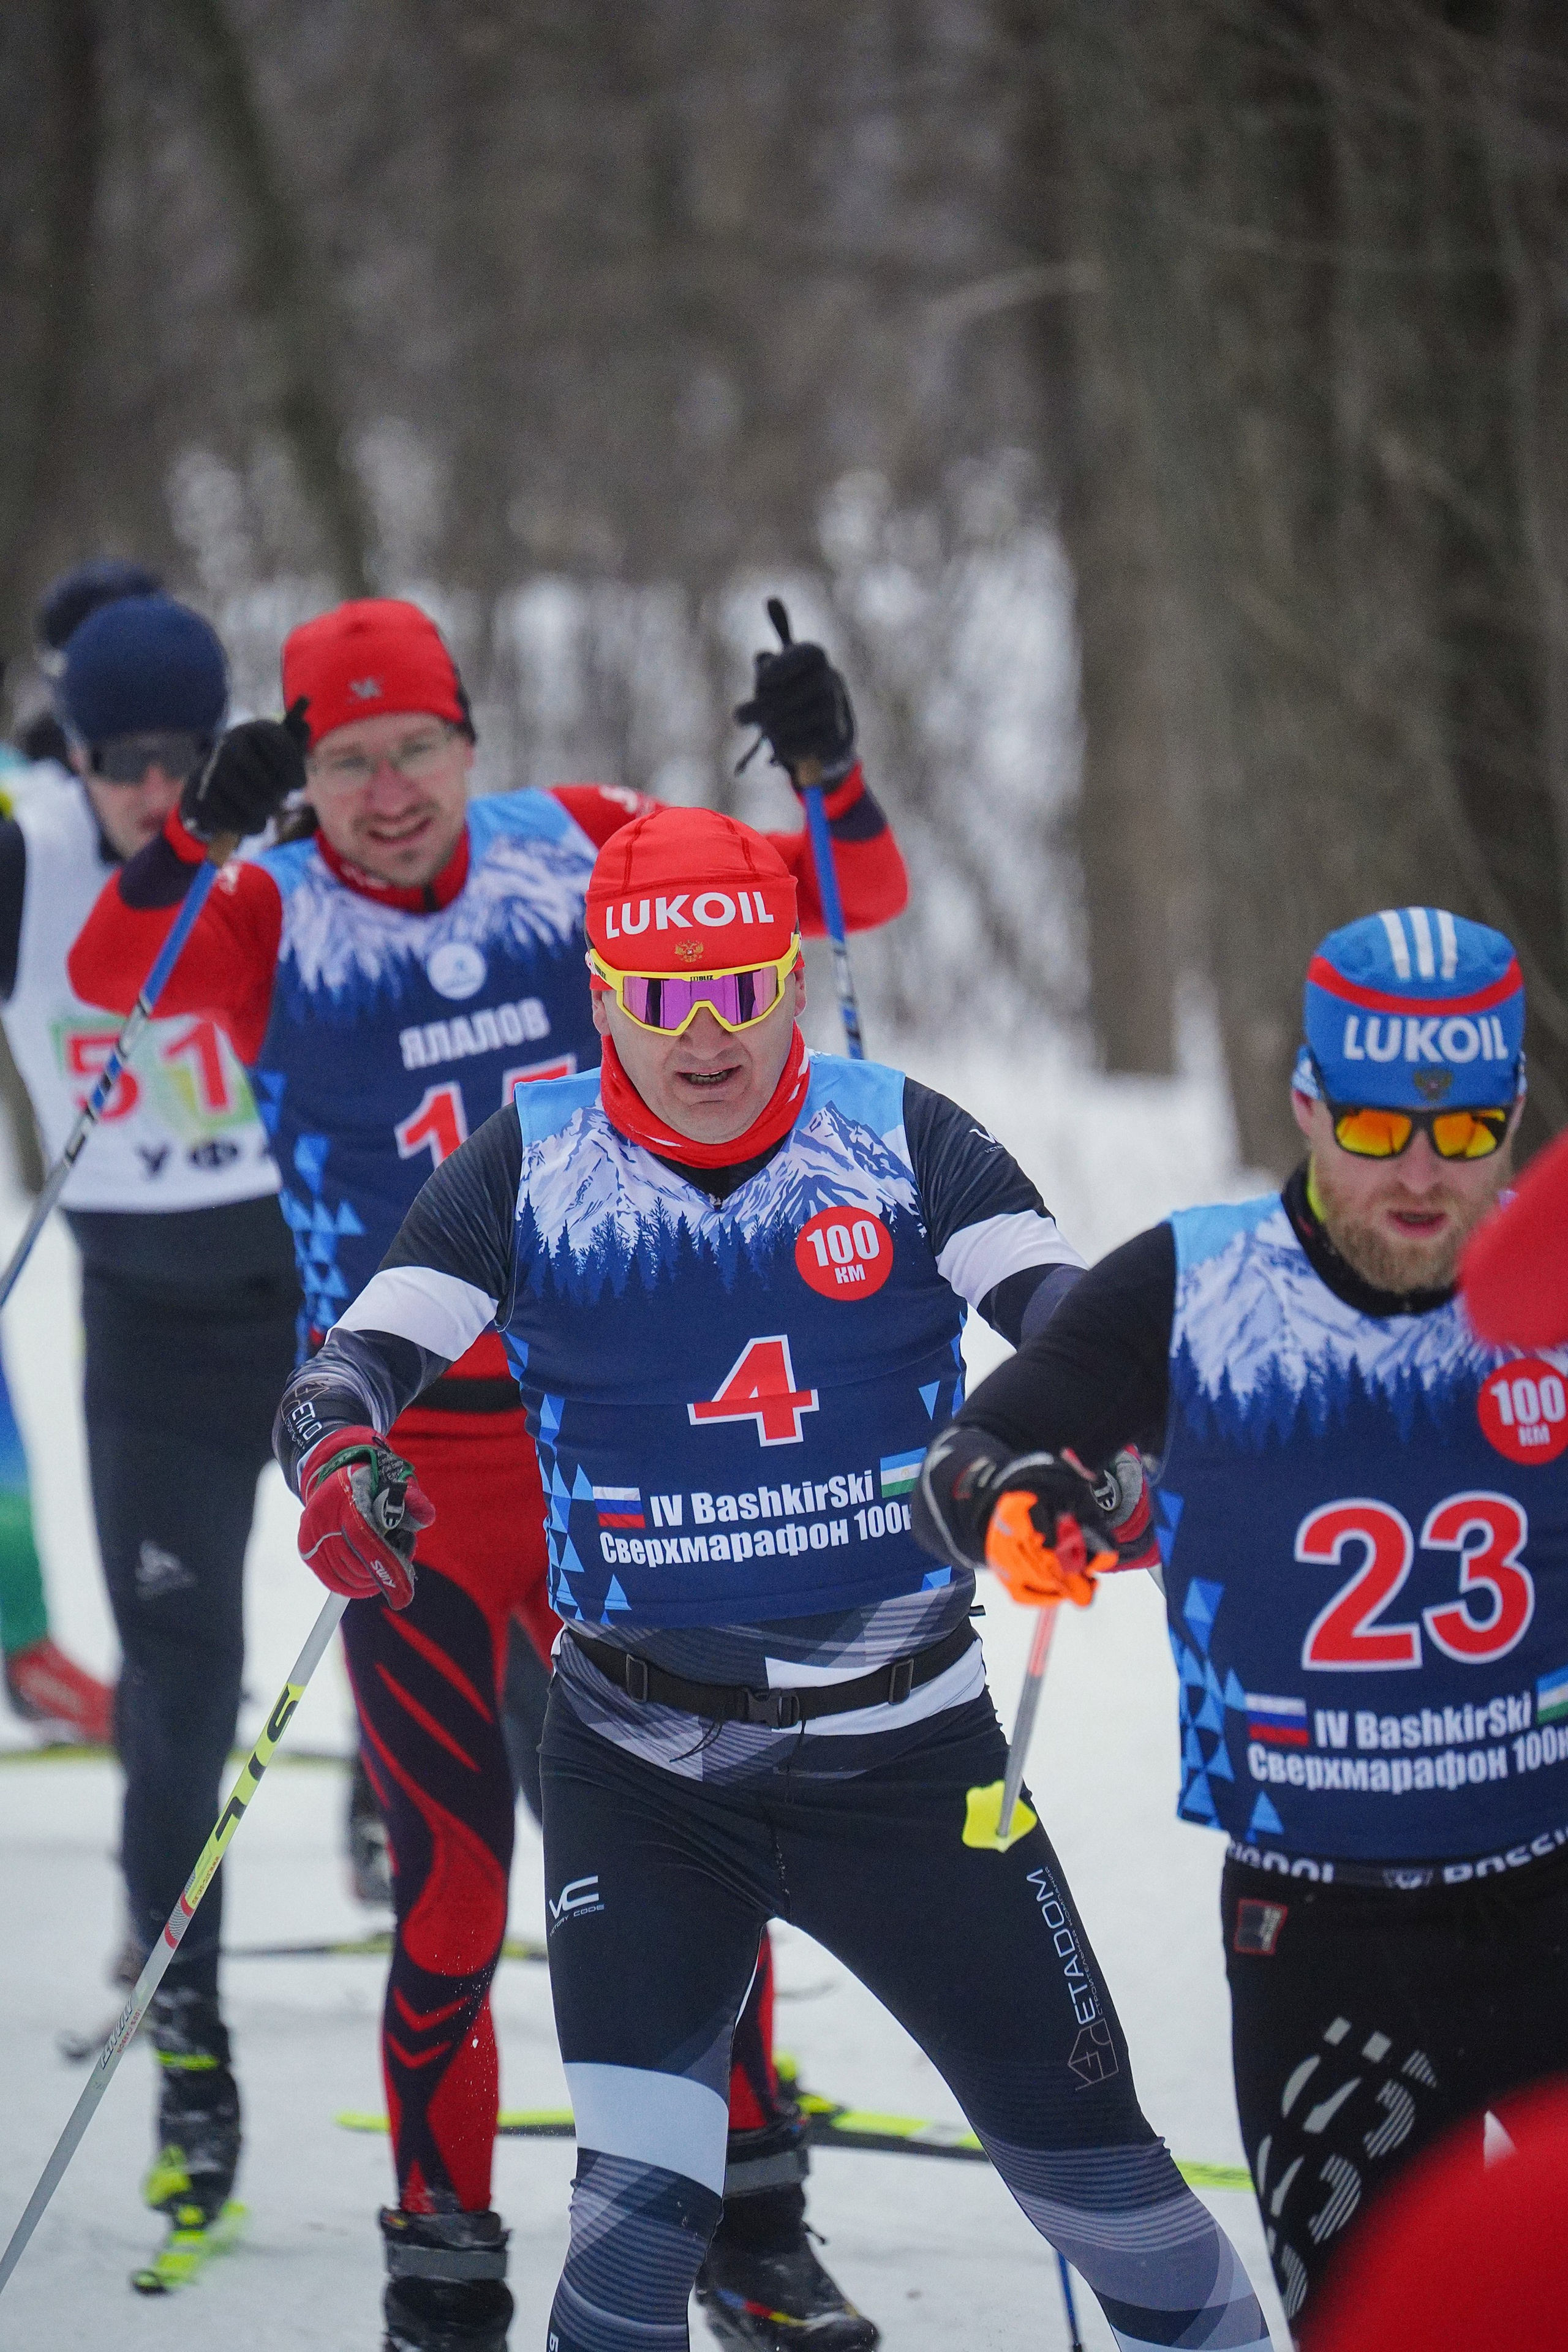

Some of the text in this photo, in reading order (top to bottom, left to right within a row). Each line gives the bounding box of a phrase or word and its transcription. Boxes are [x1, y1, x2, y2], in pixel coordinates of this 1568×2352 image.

[605, 891, 774, 939] LUKOIL
[399, 997, 550, 1070] ЯЛАЛОВ
[1343, 1015, 1509, 1063] LUKOIL
[64, 1019, 232, 1123] 51
[806, 1219, 880, 1267] 100
[835, 1265, 867, 1284] КМ
[687, 1334, 820, 1448] 4
[1490, 1376, 1566, 1426] 100
[649, 1470, 874, 1528] IV BashkirSki
[600, 1517, 849, 1568] Сверхмарафон
[1294, 1489, 1535, 1673] 23
[1314, 1691, 1532, 1750] IV BashkirSki
[1248, 1743, 1508, 1796] Сверхмарафон
[573, 1904, 605, 1917] CODE
[1027, 1868, 1096, 2025] ETADOM
